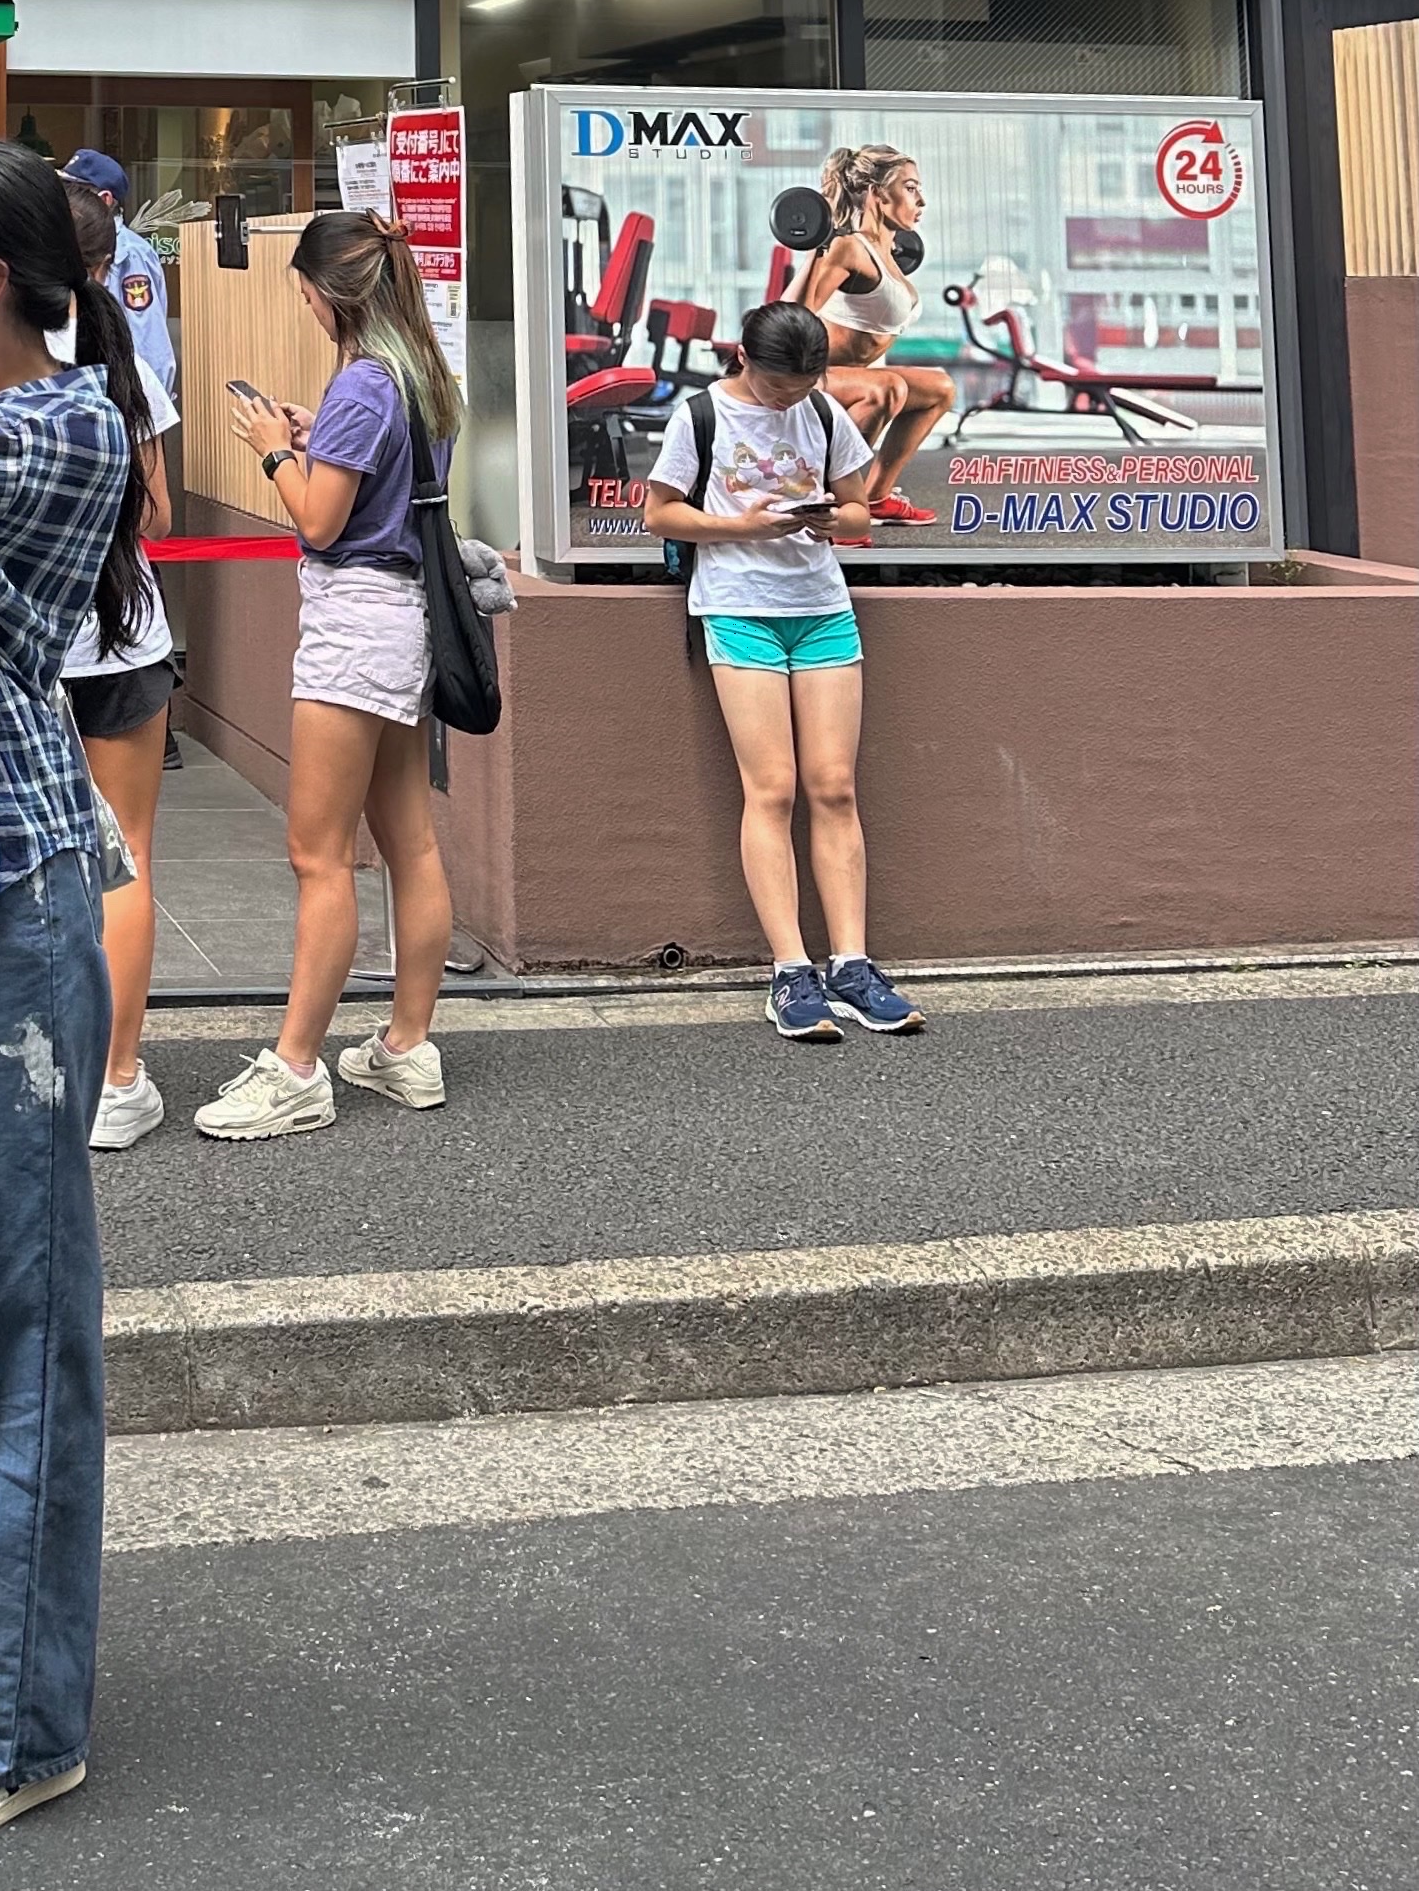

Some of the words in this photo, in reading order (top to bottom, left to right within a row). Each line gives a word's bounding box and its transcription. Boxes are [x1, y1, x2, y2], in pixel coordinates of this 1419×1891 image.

[391, 129, 460, 156] 「受付番号」にて
[628, 149, 752, 160] STUDIO
[391, 157, 460, 185] 順番にご案内中
[1175, 150, 1224, 182] 24
[1176, 184, 1225, 195] HOURS
[951, 492, 1101, 532] D-MAX
[1105, 491, 1260, 532] STUDIO
